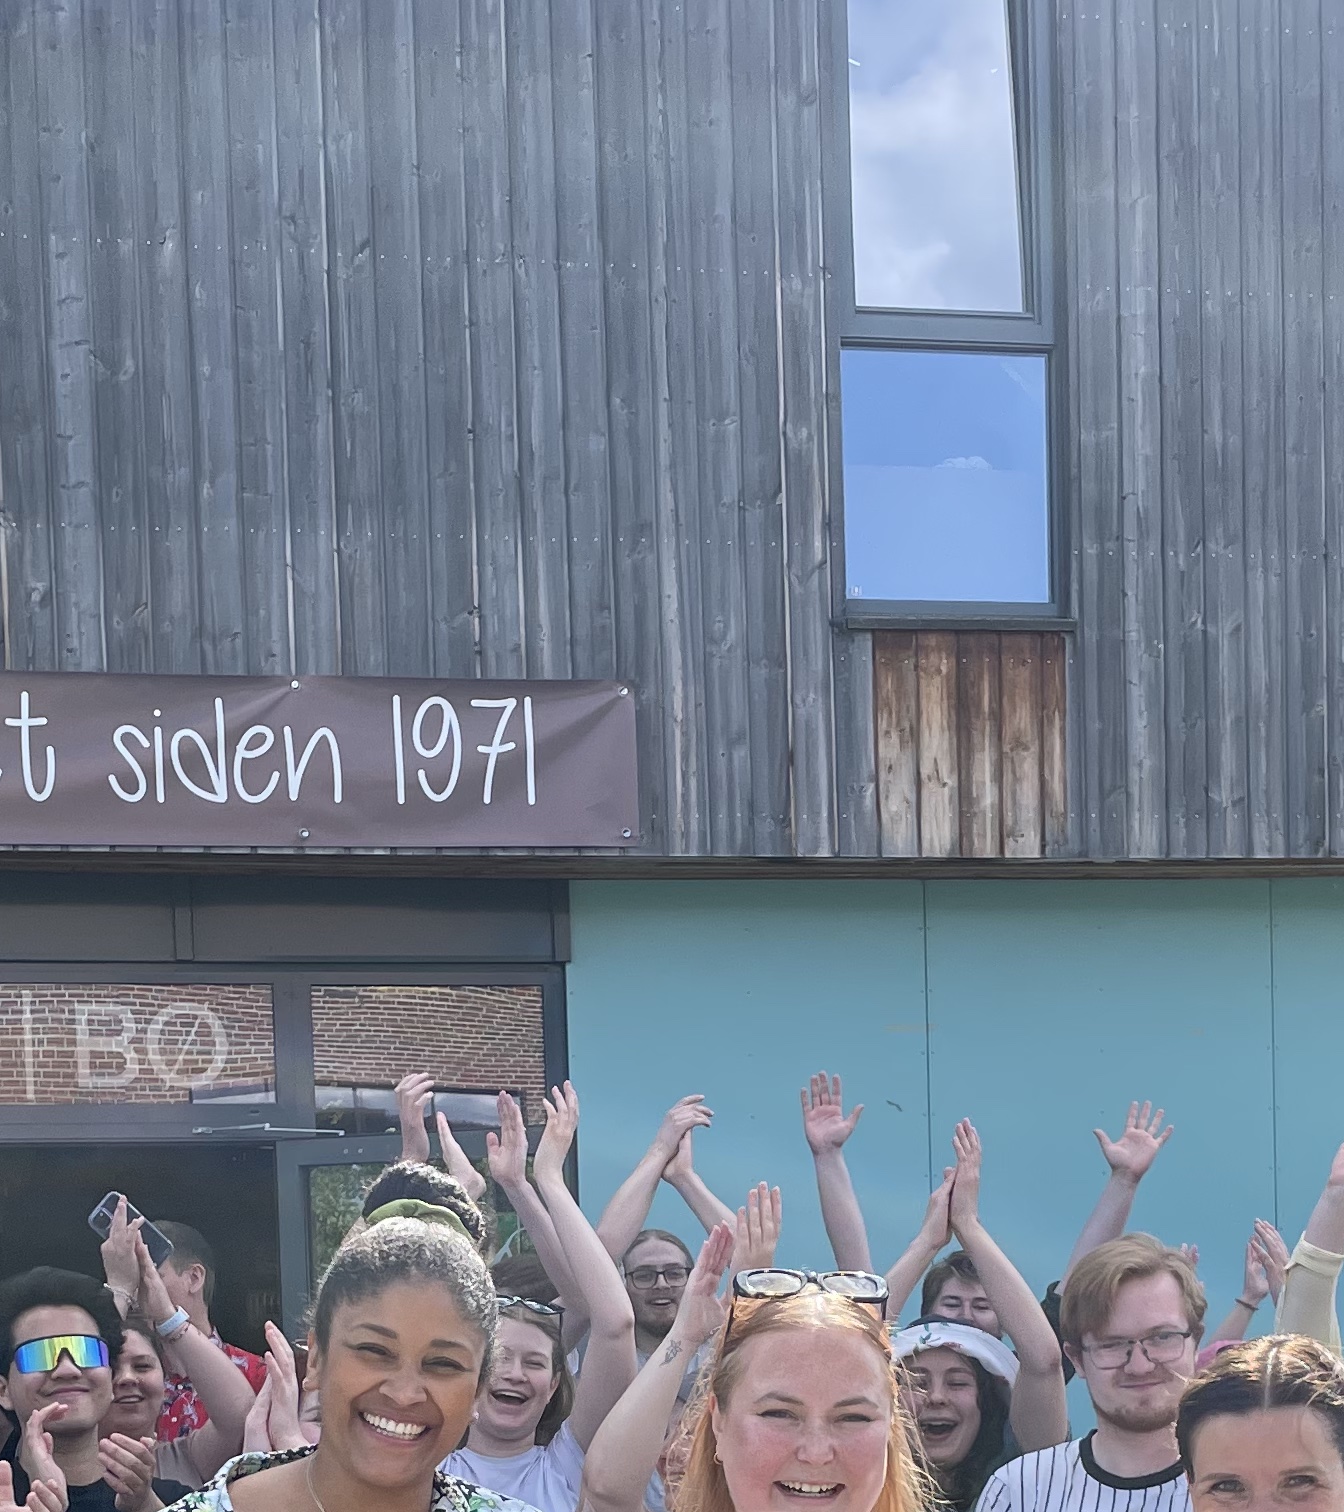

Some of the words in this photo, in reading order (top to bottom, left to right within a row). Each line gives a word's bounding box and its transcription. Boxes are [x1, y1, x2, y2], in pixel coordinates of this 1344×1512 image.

[107, 697, 343, 804] siden
[391, 694, 537, 806] 1971
[74, 1002, 229, 1088] BØ
